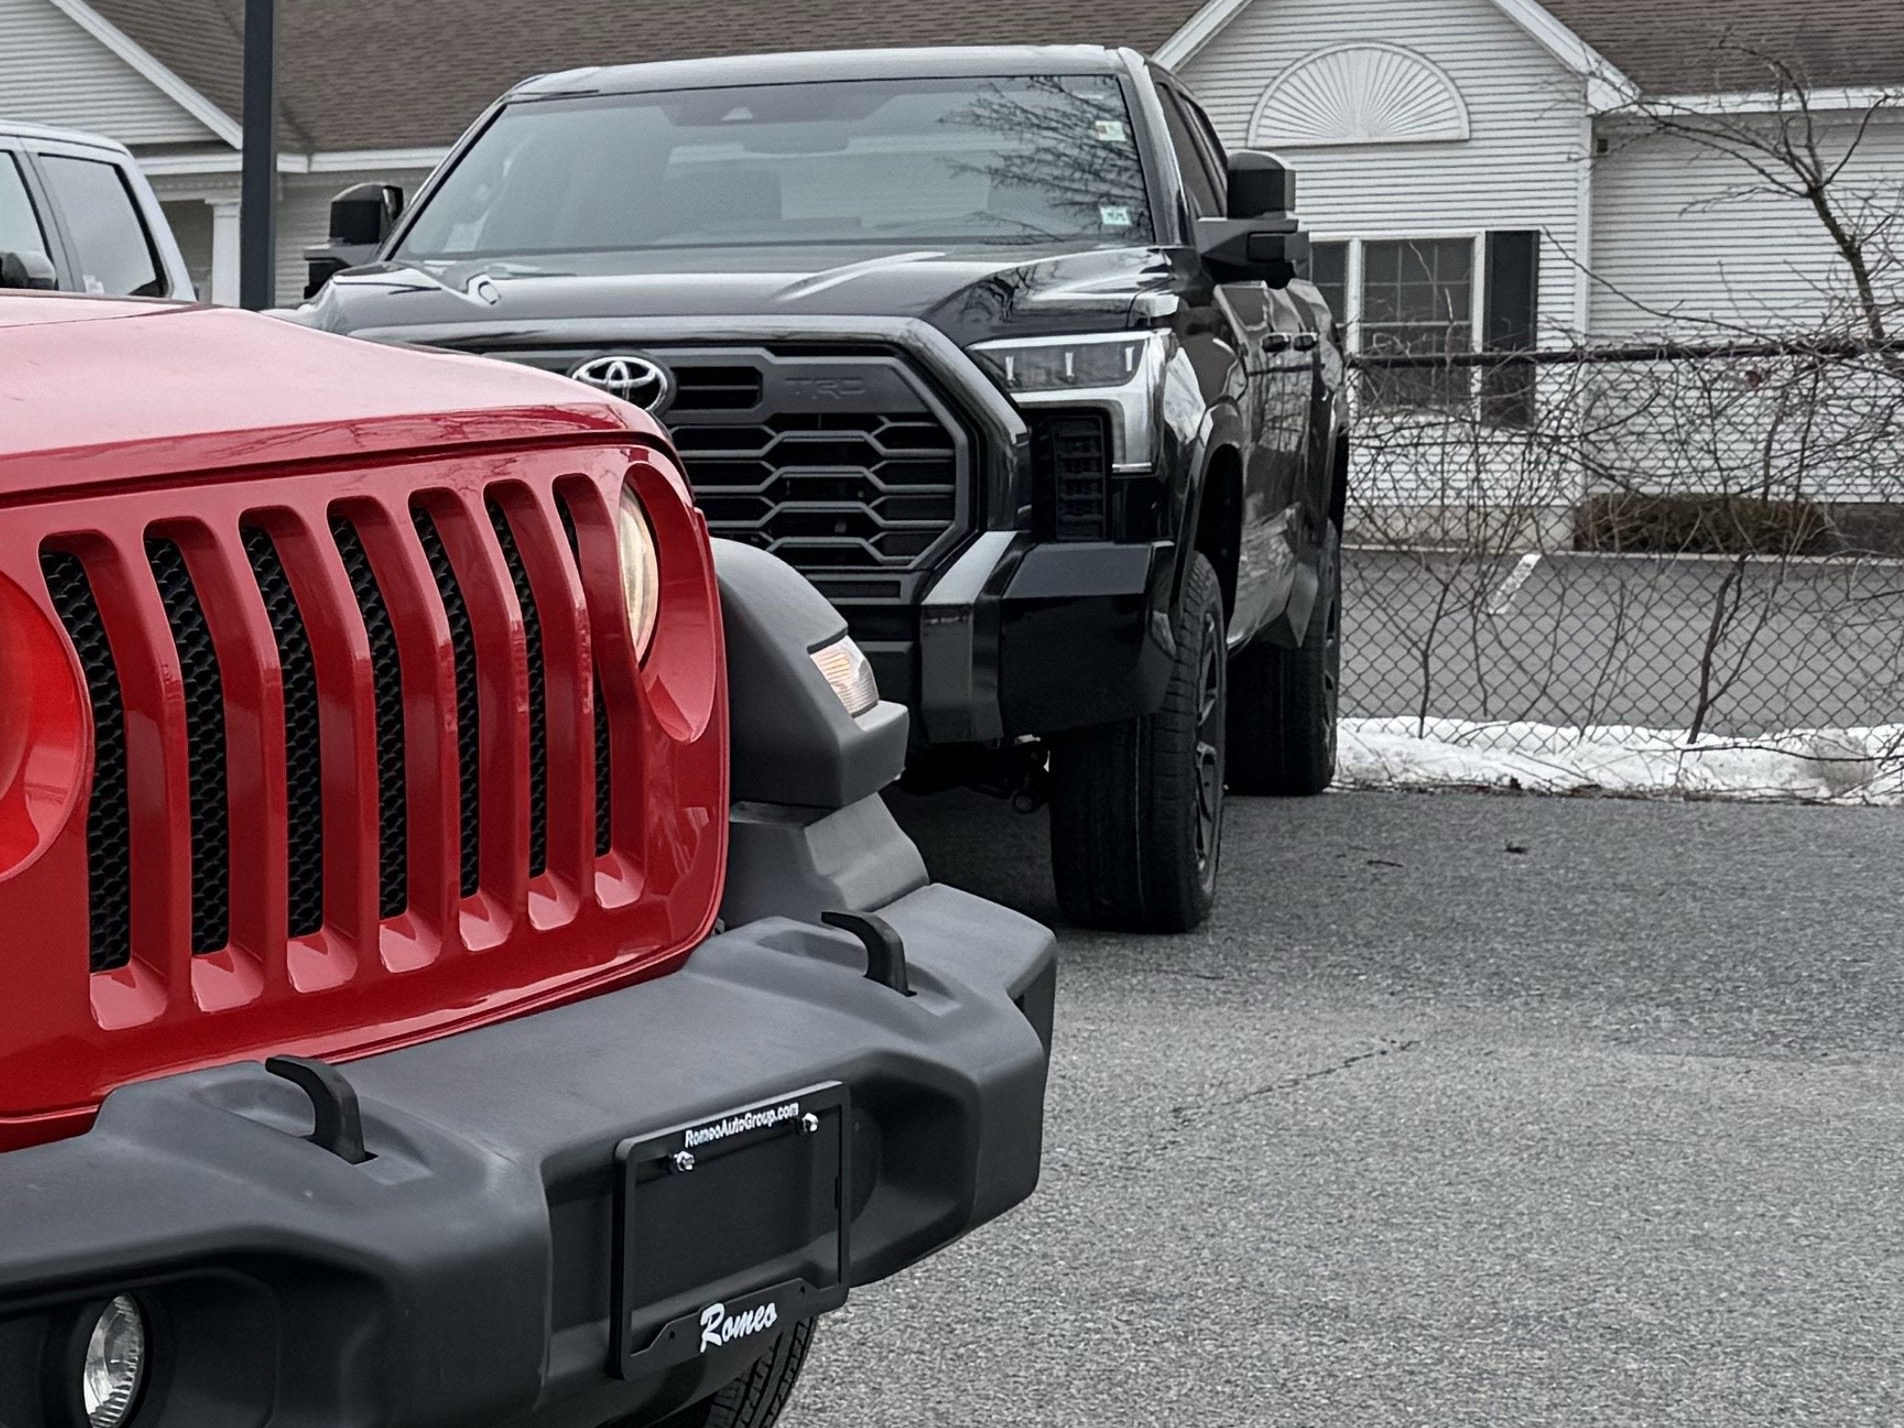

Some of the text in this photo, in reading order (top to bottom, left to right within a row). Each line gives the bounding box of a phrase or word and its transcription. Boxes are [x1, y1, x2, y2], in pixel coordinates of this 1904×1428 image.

[784, 376, 866, 400] TRD
[685, 1102, 799, 1149] RomeoAutoGroup.com
[699, 1302, 778, 1353] Romeo
